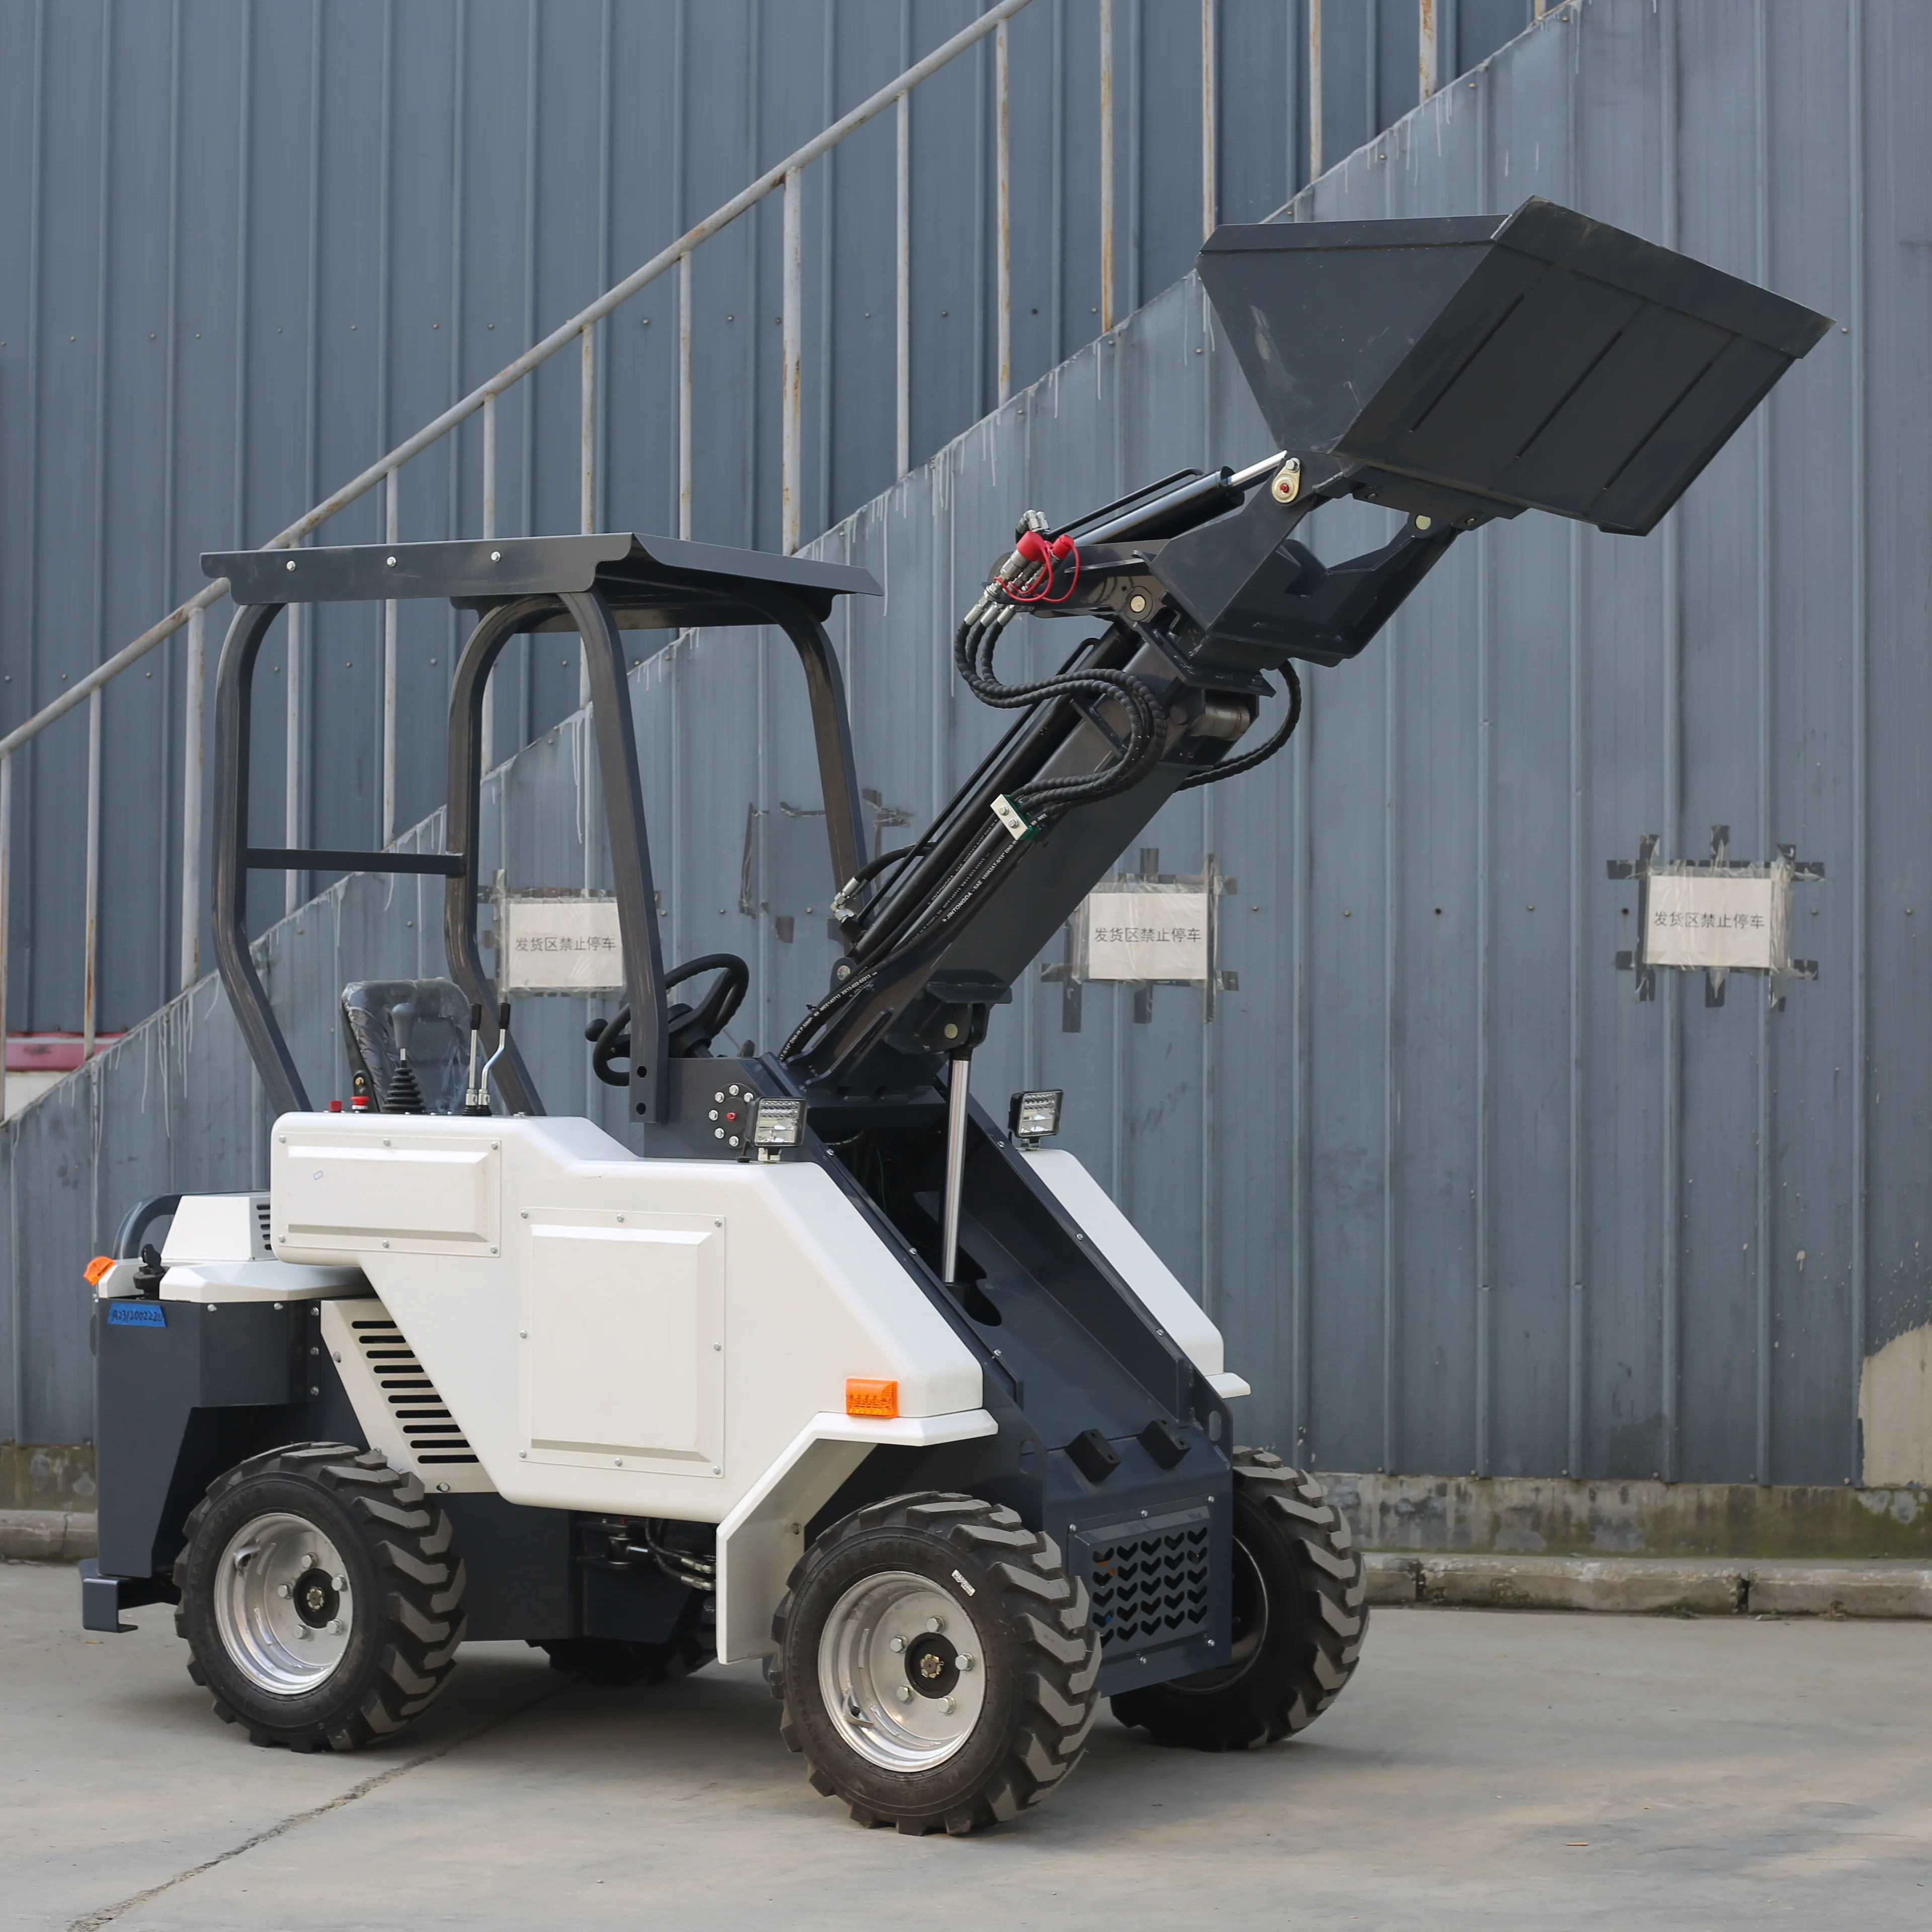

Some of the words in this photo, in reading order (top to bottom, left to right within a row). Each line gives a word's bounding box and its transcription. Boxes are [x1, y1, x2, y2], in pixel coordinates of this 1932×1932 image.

[945, 891, 973, 919] JINTONGDA
[1655, 912, 1764, 929] 发货区禁止停车
[1095, 927, 1201, 942] 发货区禁止停车
[515, 936, 616, 951] 发货区禁止停车
